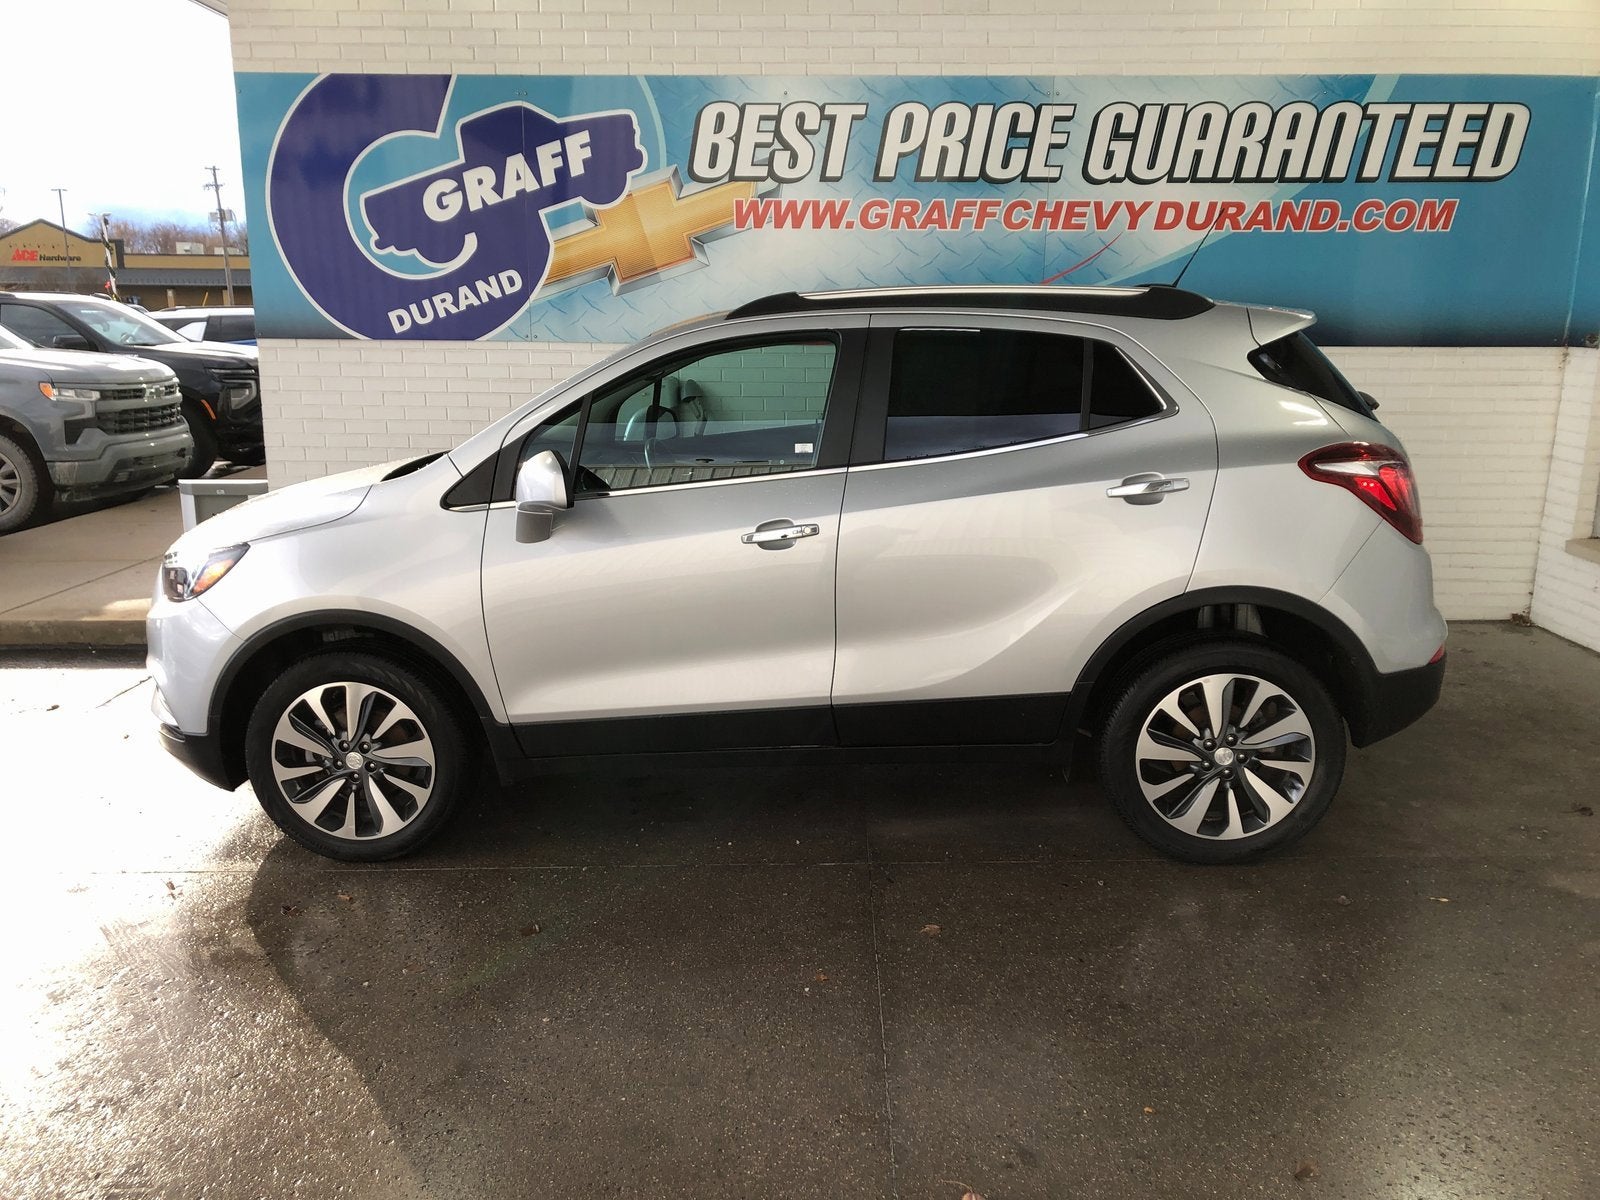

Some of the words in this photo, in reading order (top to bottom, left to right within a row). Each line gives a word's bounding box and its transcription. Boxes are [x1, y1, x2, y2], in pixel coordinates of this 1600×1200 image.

[689, 102, 868, 182] BEST
[873, 102, 1077, 183] PRICE
[1081, 100, 1532, 185] GUARANTEED
[422, 130, 593, 222] GRAFF
[734, 199, 1459, 232] WWW.GRAFFCHEVYDURAND.COM
[12, 248, 38, 261] ACE
[387, 269, 523, 334] DURAND
